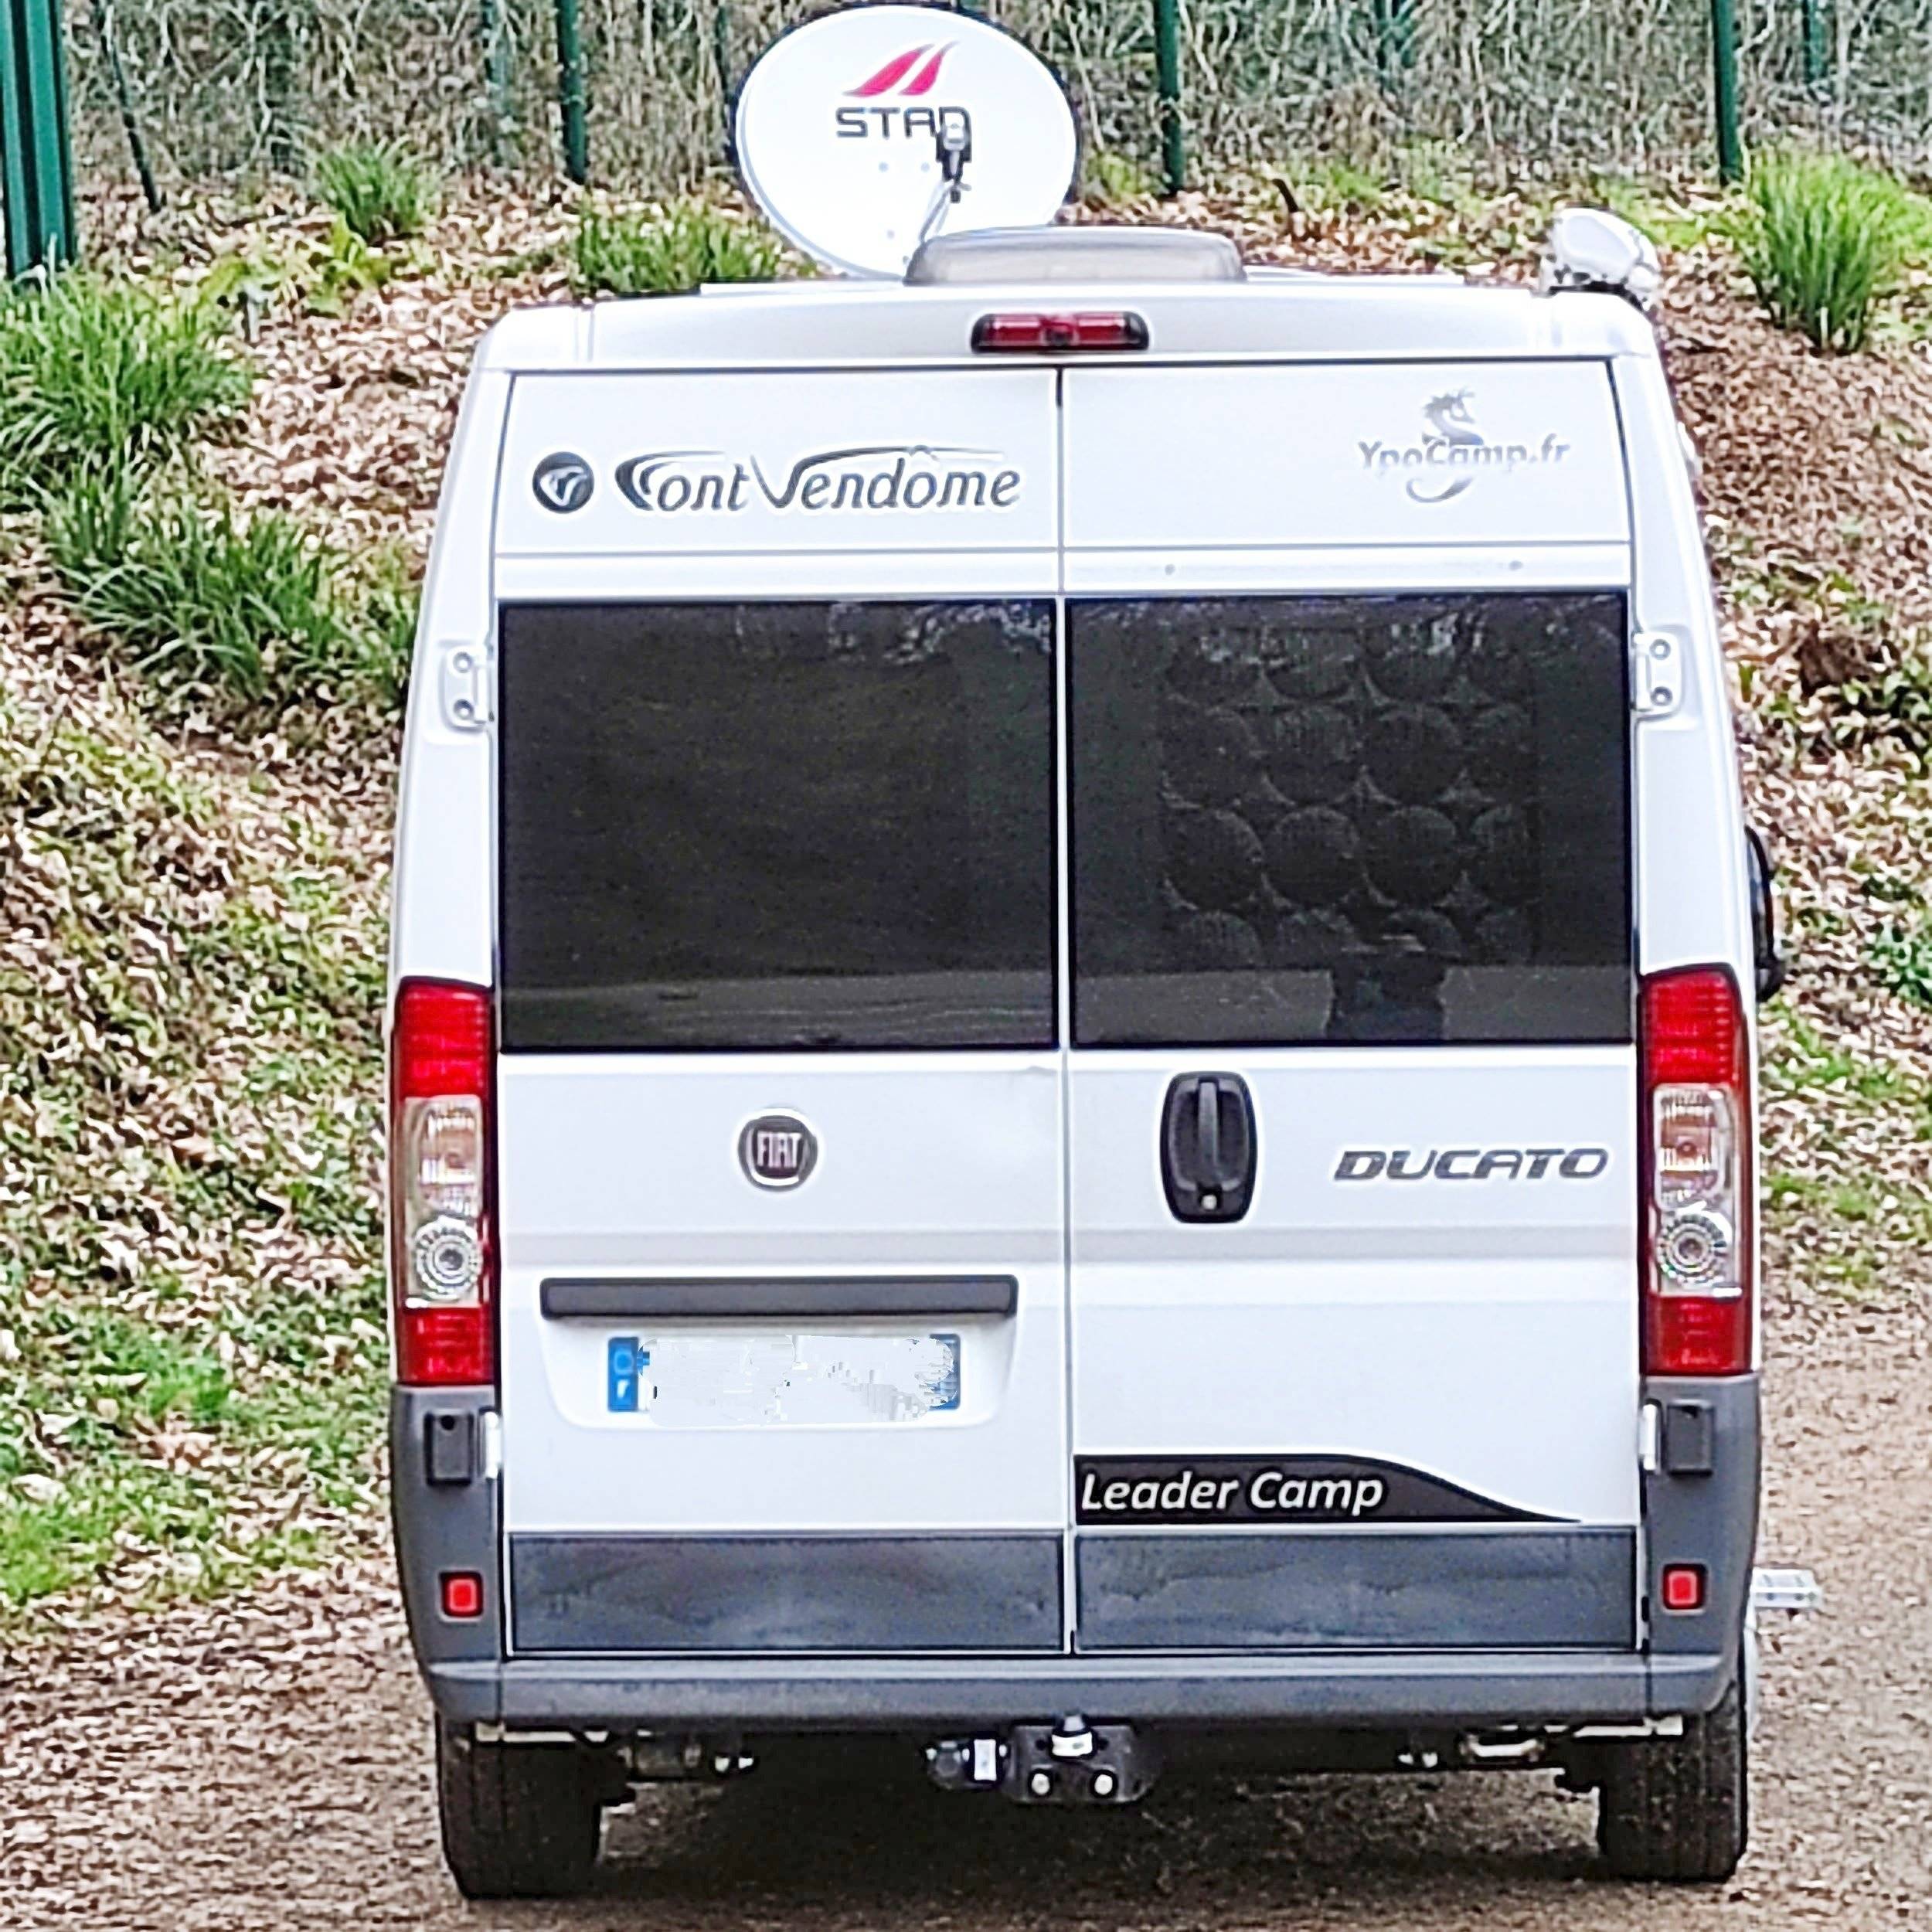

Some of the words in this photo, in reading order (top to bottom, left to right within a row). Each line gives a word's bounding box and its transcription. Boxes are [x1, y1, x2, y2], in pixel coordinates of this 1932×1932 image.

[757, 1131, 802, 1168] FIAT
[1334, 1148, 1609, 1181] DUCATO
[1082, 1470, 1240, 1511] Leader
[1250, 1471, 1384, 1516] Camp
